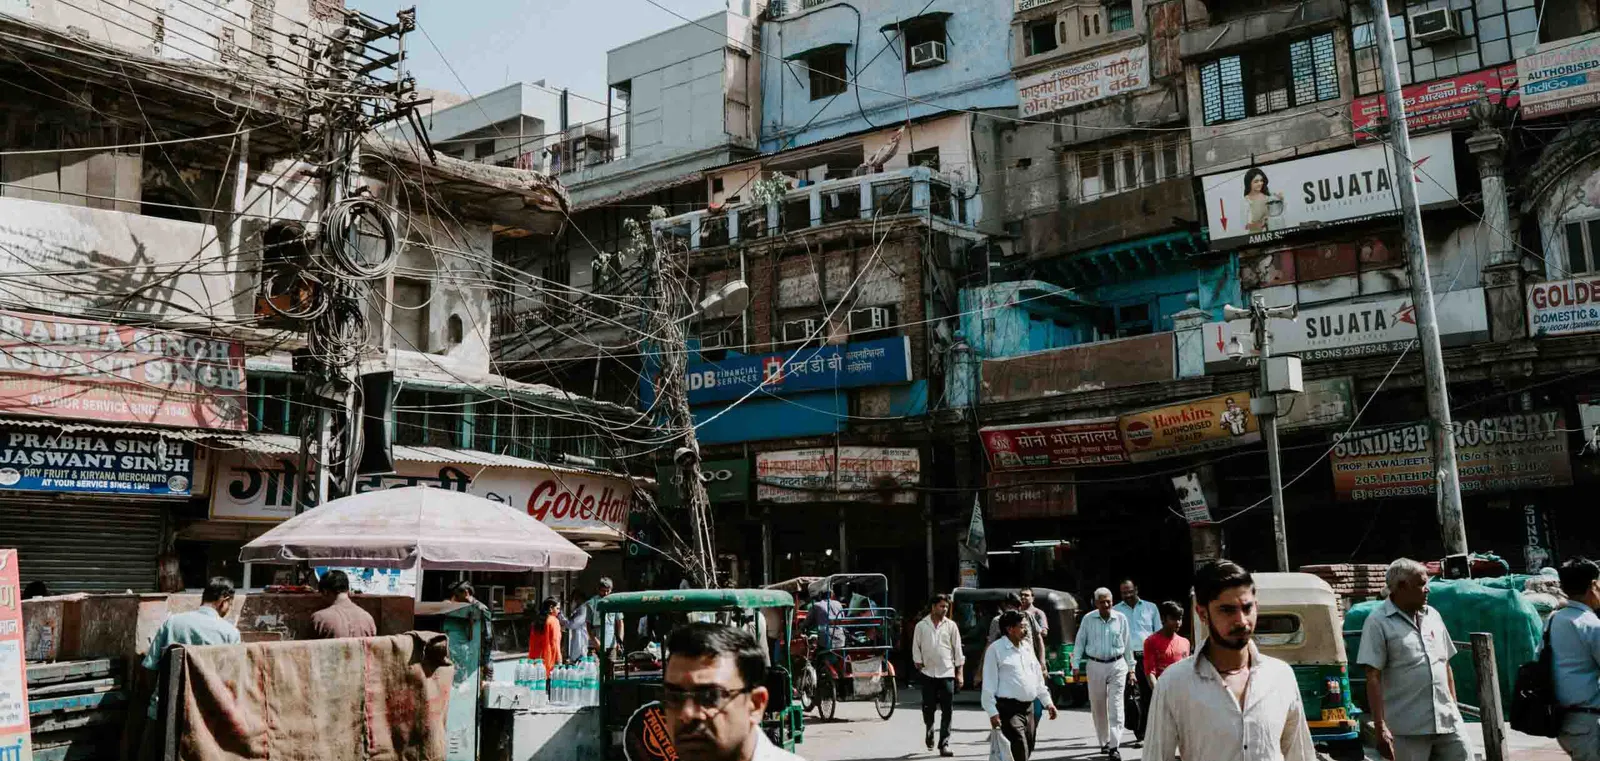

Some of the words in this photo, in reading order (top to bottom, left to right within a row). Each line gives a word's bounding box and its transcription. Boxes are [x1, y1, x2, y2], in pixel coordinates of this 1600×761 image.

[1528, 60, 1599, 81] AUTHORISED
[1527, 80, 1568, 93] IndiGo
[1302, 167, 1391, 206] SUJATA
[1248, 232, 1273, 244] AMAR
[1306, 309, 1387, 339] SUJATA
[1533, 309, 1587, 324] DOMESTIC
[1589, 308, 1598, 318] &
[132, 330, 231, 362] SINGH
[1306, 351, 1313, 360] &
[1315, 348, 1342, 360] SONS
[144, 358, 242, 390] SINGH
[716, 366, 758, 379] FINANCIAL
[716, 374, 758, 386] SERVICES
[83, 400, 129, 413] SERVICE
[1152, 405, 1215, 429] Hawkins
[1162, 420, 1213, 436] AUTHORISED
[1333, 423, 1430, 458] SUNDEEP
[1452, 410, 1559, 449] ROCKERY
[9, 432, 109, 452] PRABHA
[1015, 431, 1047, 449] सोनी
[1050, 427, 1119, 446] भोजनालय
[0, 449, 116, 468] JASWANT
[120, 455, 190, 473] SINGH
[1367, 457, 1425, 469] KAWALJEET
[24, 468, 41, 477] DRY
[43, 469, 69, 479] FRUIT
[71, 471, 77, 479] &
[80, 471, 116, 481] KIRYANA
[117, 473, 167, 483] MERCHANTS
[76, 480, 108, 488] SERVICE
[110, 481, 131, 489] SINCE
[527, 480, 594, 521] Gole
